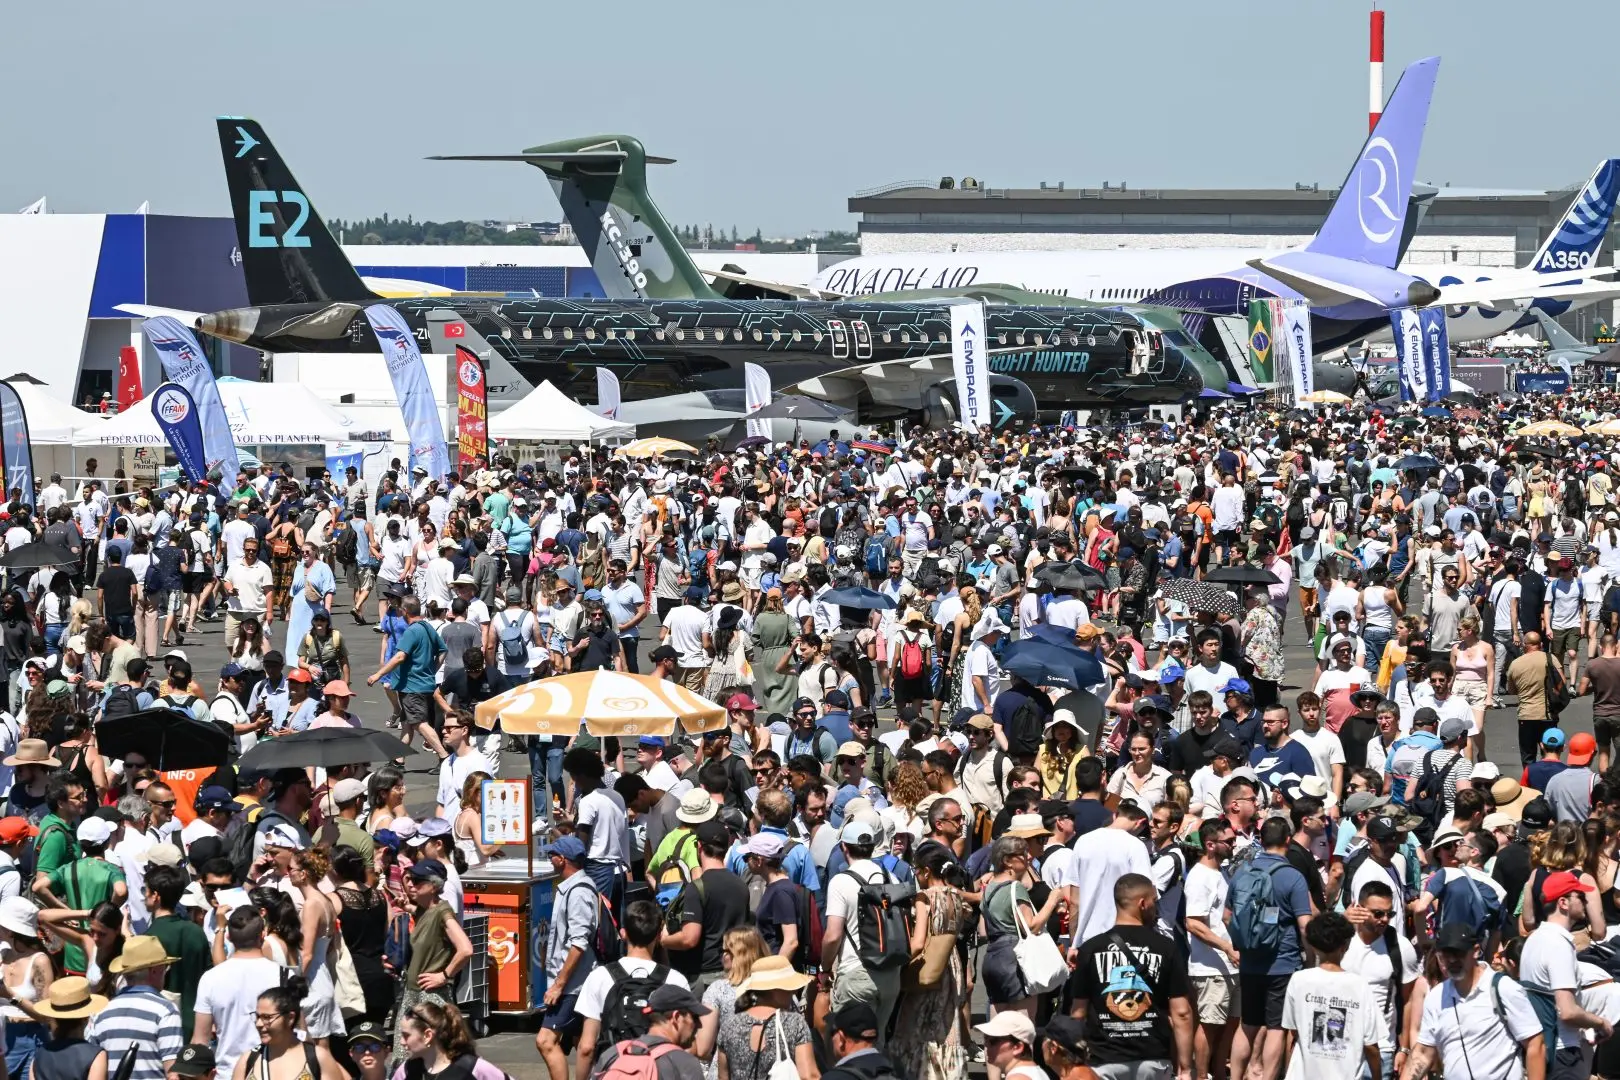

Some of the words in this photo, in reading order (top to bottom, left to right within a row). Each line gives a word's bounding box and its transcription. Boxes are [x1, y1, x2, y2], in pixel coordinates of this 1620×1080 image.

[249, 190, 312, 248] E2
[602, 211, 648, 289] KC-390
[1540, 250, 1591, 270] A350
[826, 267, 929, 295] RIYADH
[932, 267, 979, 289] AIR
[1032, 351, 1090, 373] HUNTER
[1430, 333, 1443, 391] EMBRAER
[964, 339, 978, 418] EMBRAER
[164, 404, 186, 415] FFAM
[236, 434, 257, 444] VOL
[259, 434, 272, 443] EN
[167, 770, 196, 781] INFO
[1305, 992, 1327, 1005] Create
[1329, 996, 1360, 1010] Miracles
